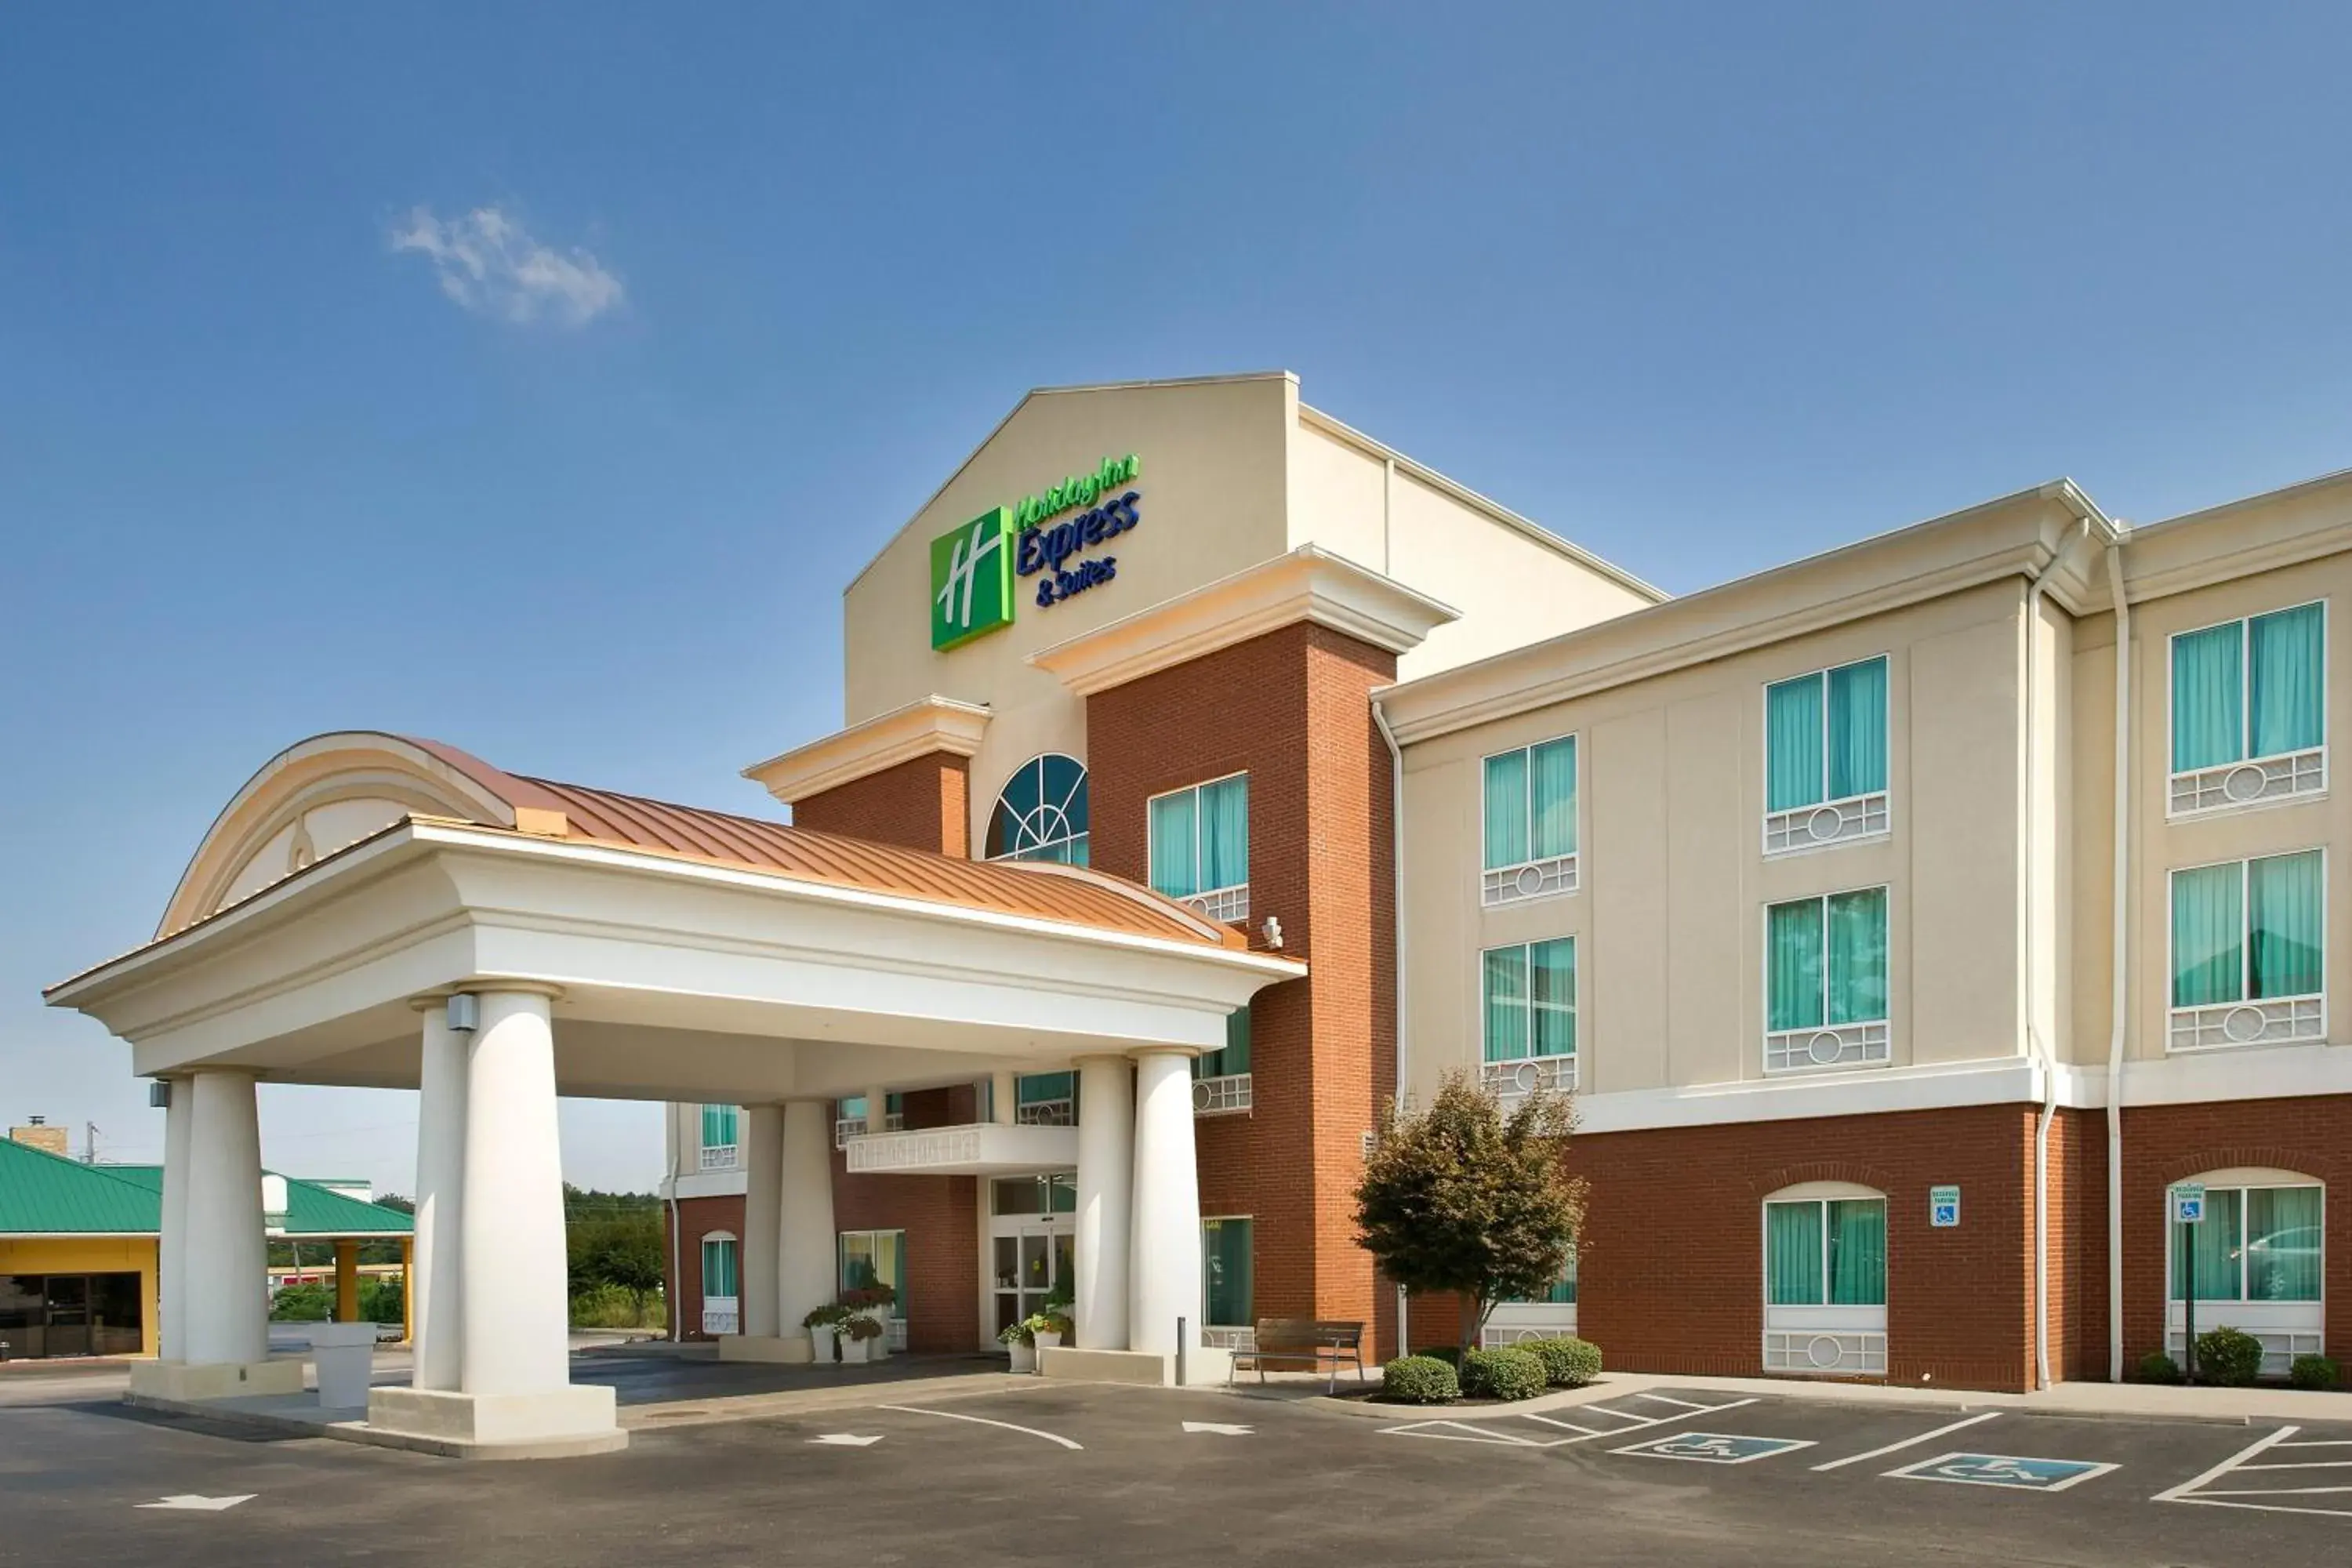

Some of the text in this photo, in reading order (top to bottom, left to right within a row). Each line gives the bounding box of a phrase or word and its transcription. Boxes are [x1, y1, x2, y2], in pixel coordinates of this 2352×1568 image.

[1014, 453, 1140, 532] Holiday Inn
[1016, 491, 1141, 576] Express
[1036, 555, 1117, 608] & Suites
